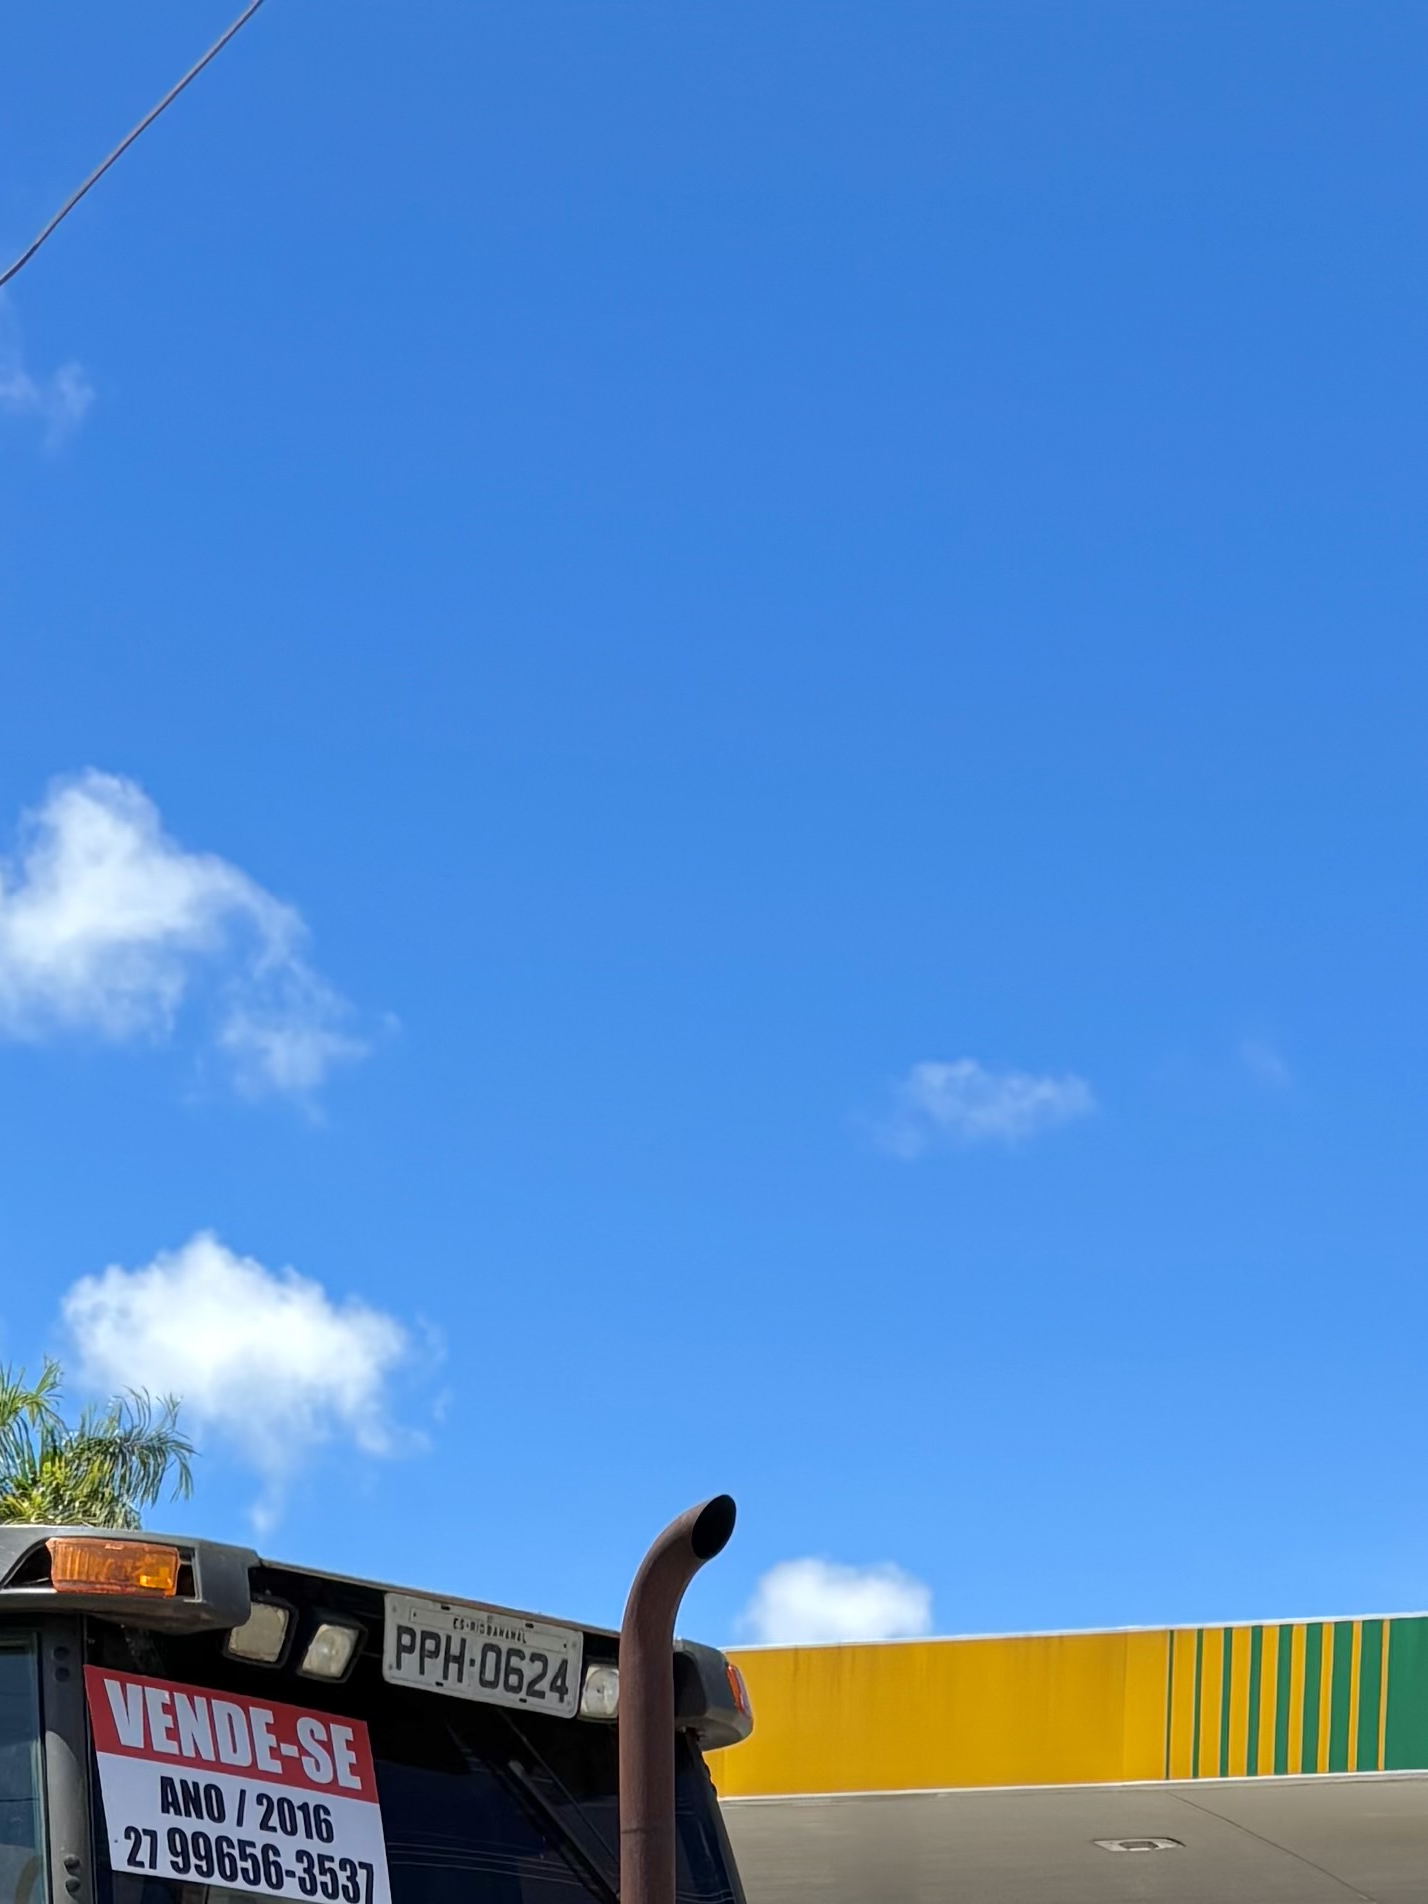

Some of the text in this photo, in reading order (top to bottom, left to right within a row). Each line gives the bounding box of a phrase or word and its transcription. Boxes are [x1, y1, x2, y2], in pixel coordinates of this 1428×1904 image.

[103, 1678, 362, 1790] VENDE-SE
[160, 1776, 334, 1844] ANO / 2016
[124, 1826, 158, 1870] 27
